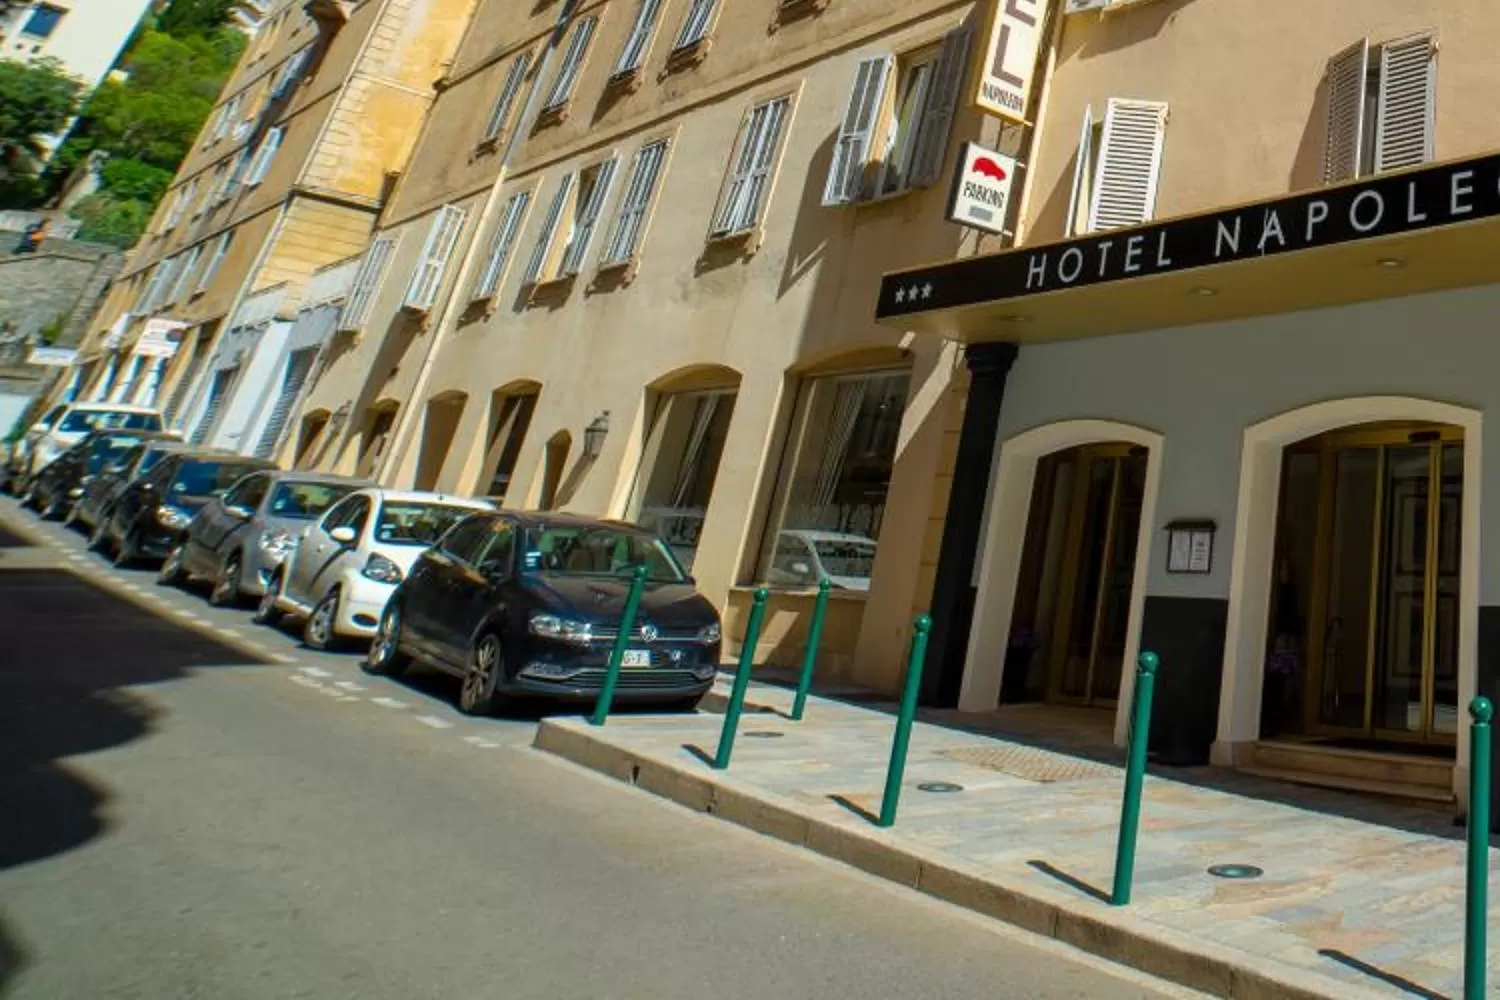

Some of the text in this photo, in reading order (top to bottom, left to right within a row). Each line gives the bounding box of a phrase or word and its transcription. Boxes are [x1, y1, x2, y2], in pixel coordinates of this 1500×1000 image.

[982, 81, 1024, 113] NAPOLEON
[963, 180, 1005, 209] PARKING
[1025, 230, 1172, 289] HOTEL
